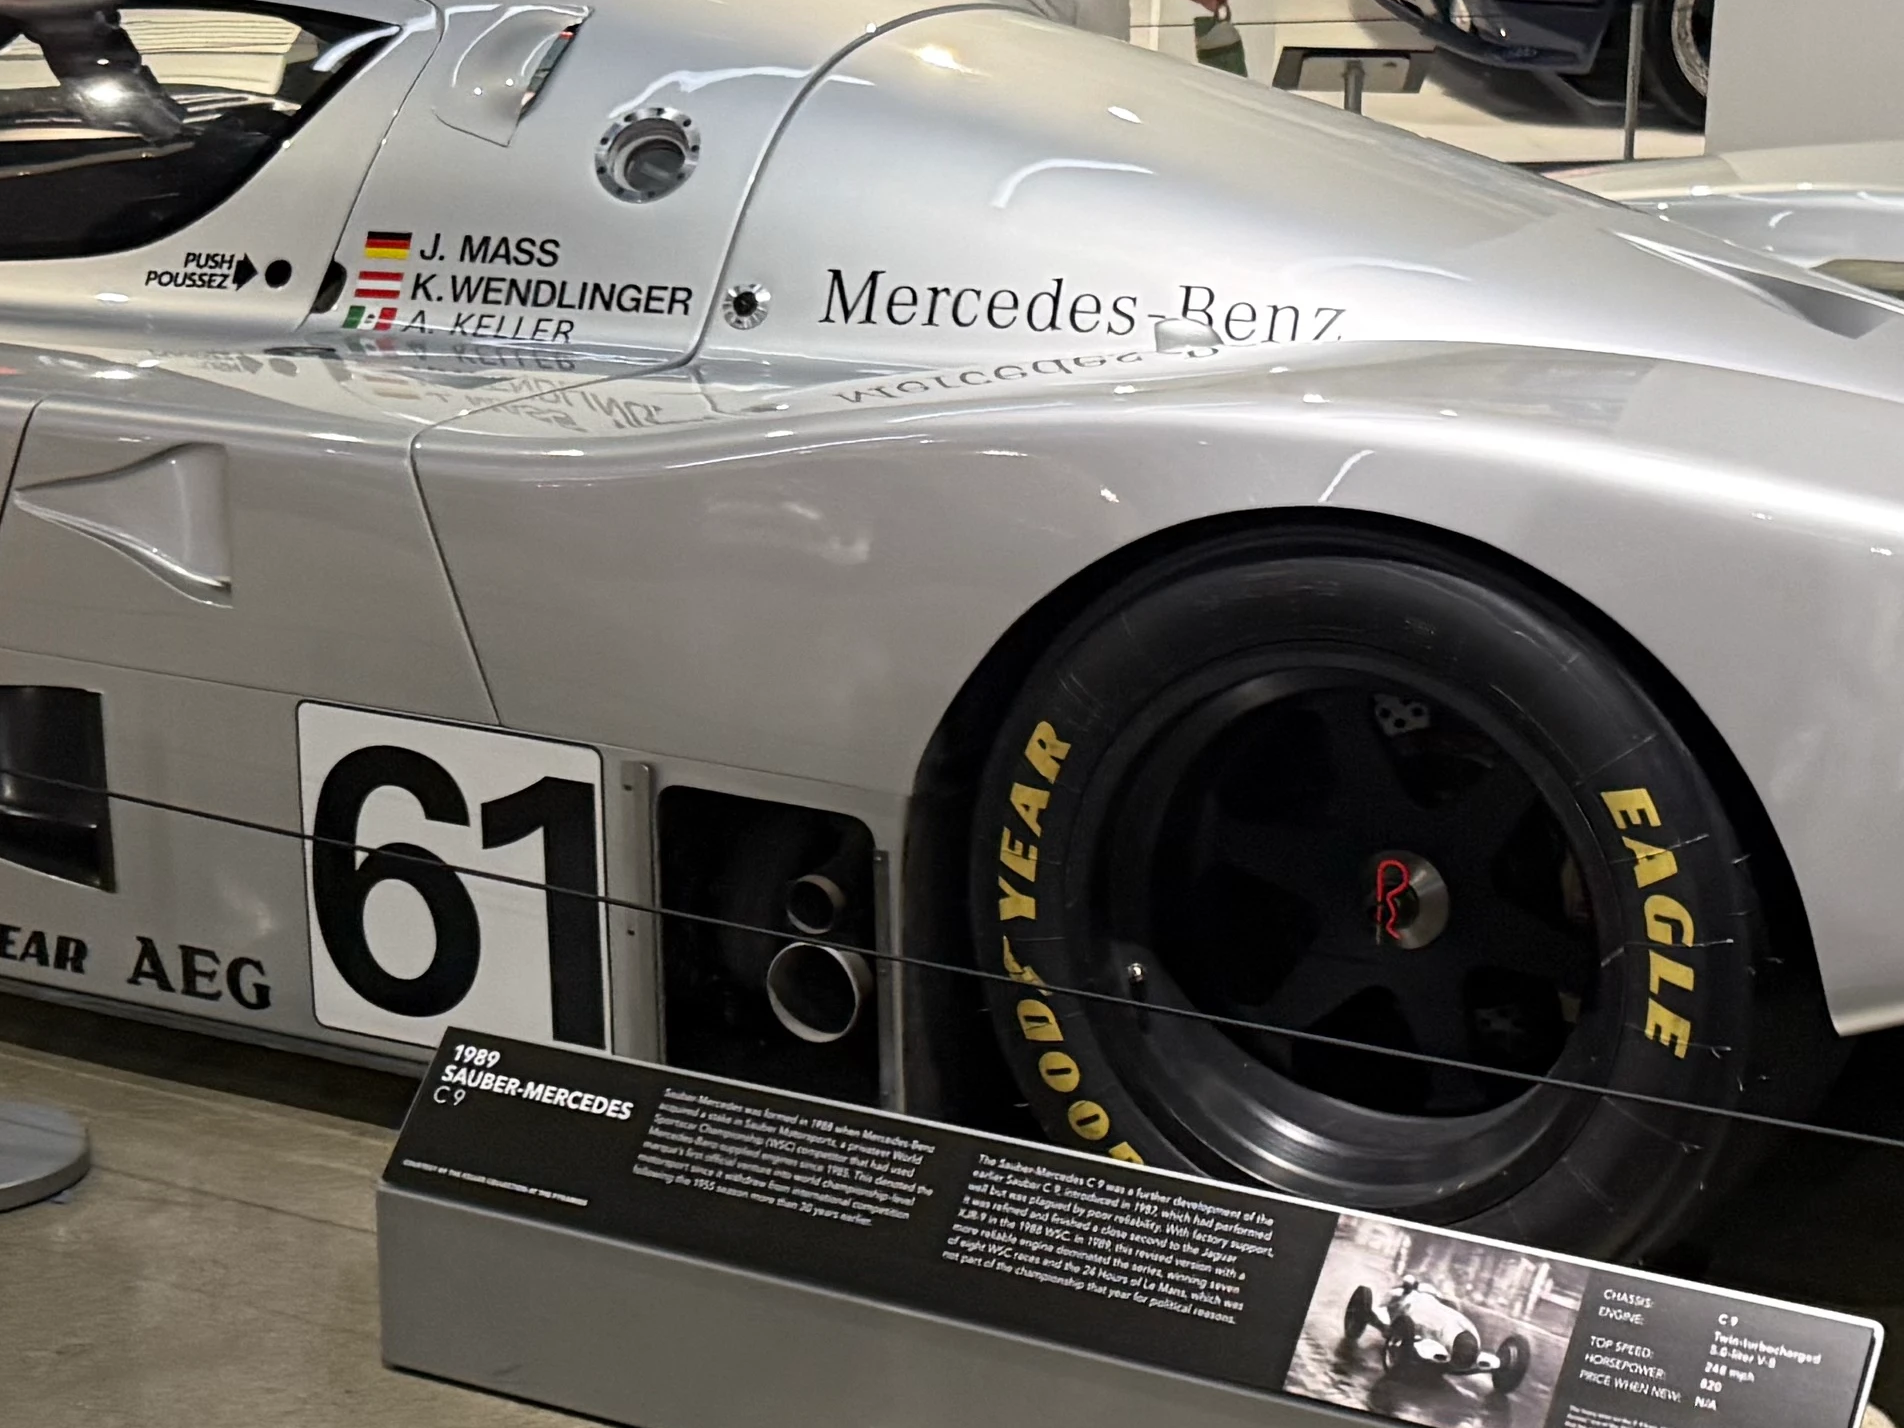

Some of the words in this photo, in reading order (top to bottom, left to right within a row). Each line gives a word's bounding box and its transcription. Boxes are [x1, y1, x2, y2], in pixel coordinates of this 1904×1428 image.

[184, 251, 234, 271] PUSH
[419, 232, 445, 262] J.
[458, 233, 561, 268] MASS
[144, 270, 228, 291] POUSSEZ
[817, 268, 1347, 344] Mercedes-Benz
[401, 311, 434, 334] A.
[452, 313, 575, 344] KELLER
[998, 720, 1072, 921] YEAR
[312, 744, 607, 1052] 61
[1599, 787, 1695, 1060] EAGLE
[126, 935, 272, 1011] AEG
[452, 1043, 501, 1069] 1989
[433, 1085, 452, 1105] C
[452, 1088, 467, 1108] 9
[441, 1064, 635, 1122] SAUBER-MERCEDES
[979, 1153, 997, 1166] The
[1192, 1214, 1215, 1228] had
[1603, 1289, 1653, 1308] CHASSIS:
[1718, 1313, 1729, 1326] C
[1590, 1335, 1614, 1349] TOP
[1615, 1341, 1654, 1359] SPEED:
[1579, 1369, 1611, 1386] PRICE
[1614, 1377, 1650, 1395] WHEN
